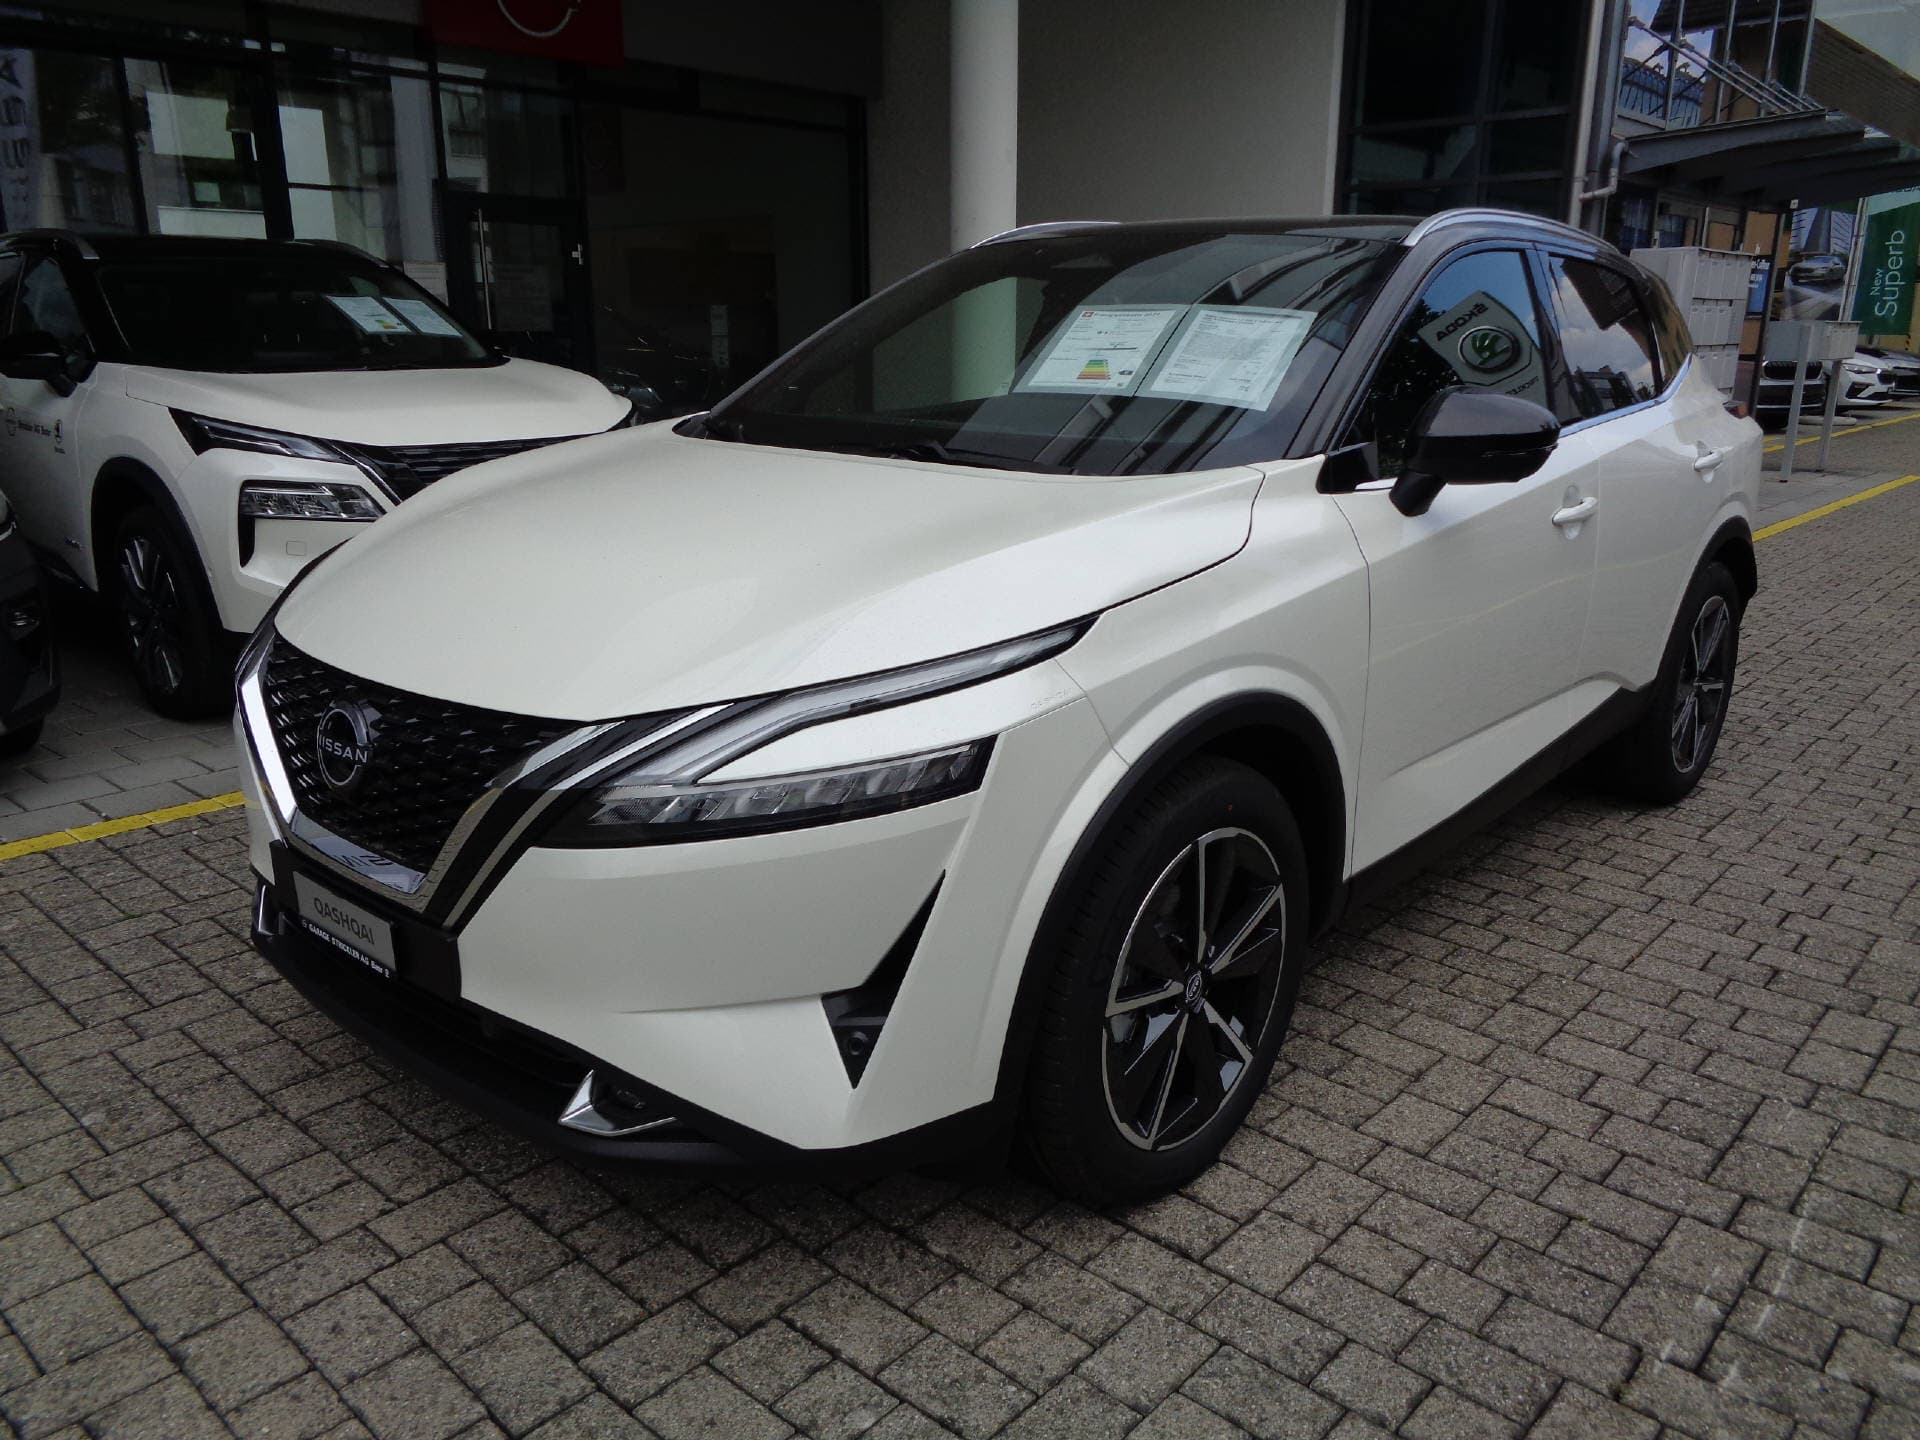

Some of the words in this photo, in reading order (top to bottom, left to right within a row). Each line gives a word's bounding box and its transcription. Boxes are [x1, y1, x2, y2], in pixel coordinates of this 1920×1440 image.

[1871, 269, 1883, 295] New
[1875, 230, 1905, 316] Superb
[314, 896, 375, 945] QASHQAI
